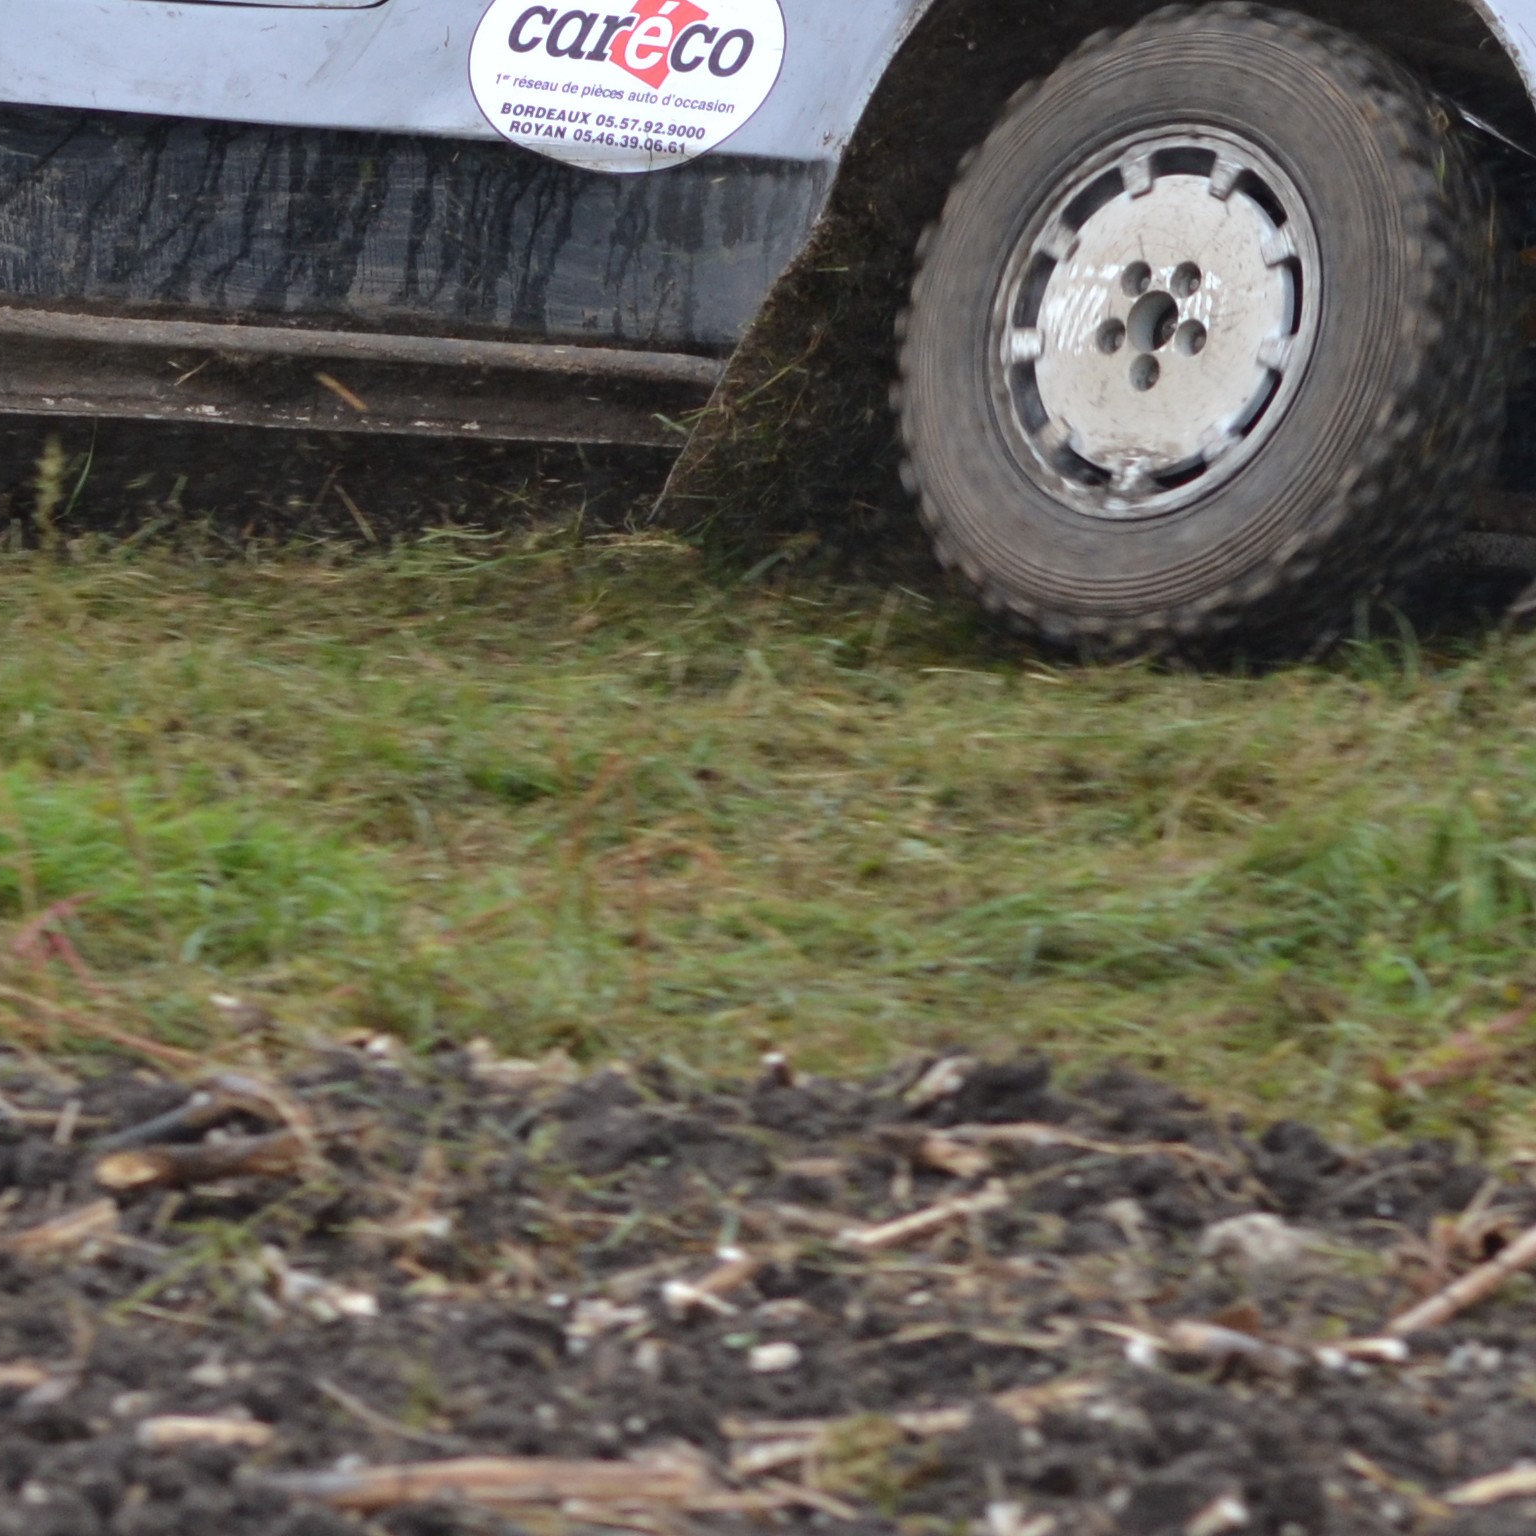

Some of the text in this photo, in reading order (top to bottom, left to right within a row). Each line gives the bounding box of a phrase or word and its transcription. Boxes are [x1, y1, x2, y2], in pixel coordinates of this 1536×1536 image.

[508, 1, 754, 77] caréco
[513, 75, 558, 92] réseau
[561, 80, 579, 94] de
[581, 82, 624, 101] pièces
[628, 90, 659, 105] auto
[662, 94, 735, 115] d'occasion
[500, 102, 706, 140] BORDEAUX 05.57.92.9000
[509, 120, 686, 154] ROYAN 05.46.39.06.61
